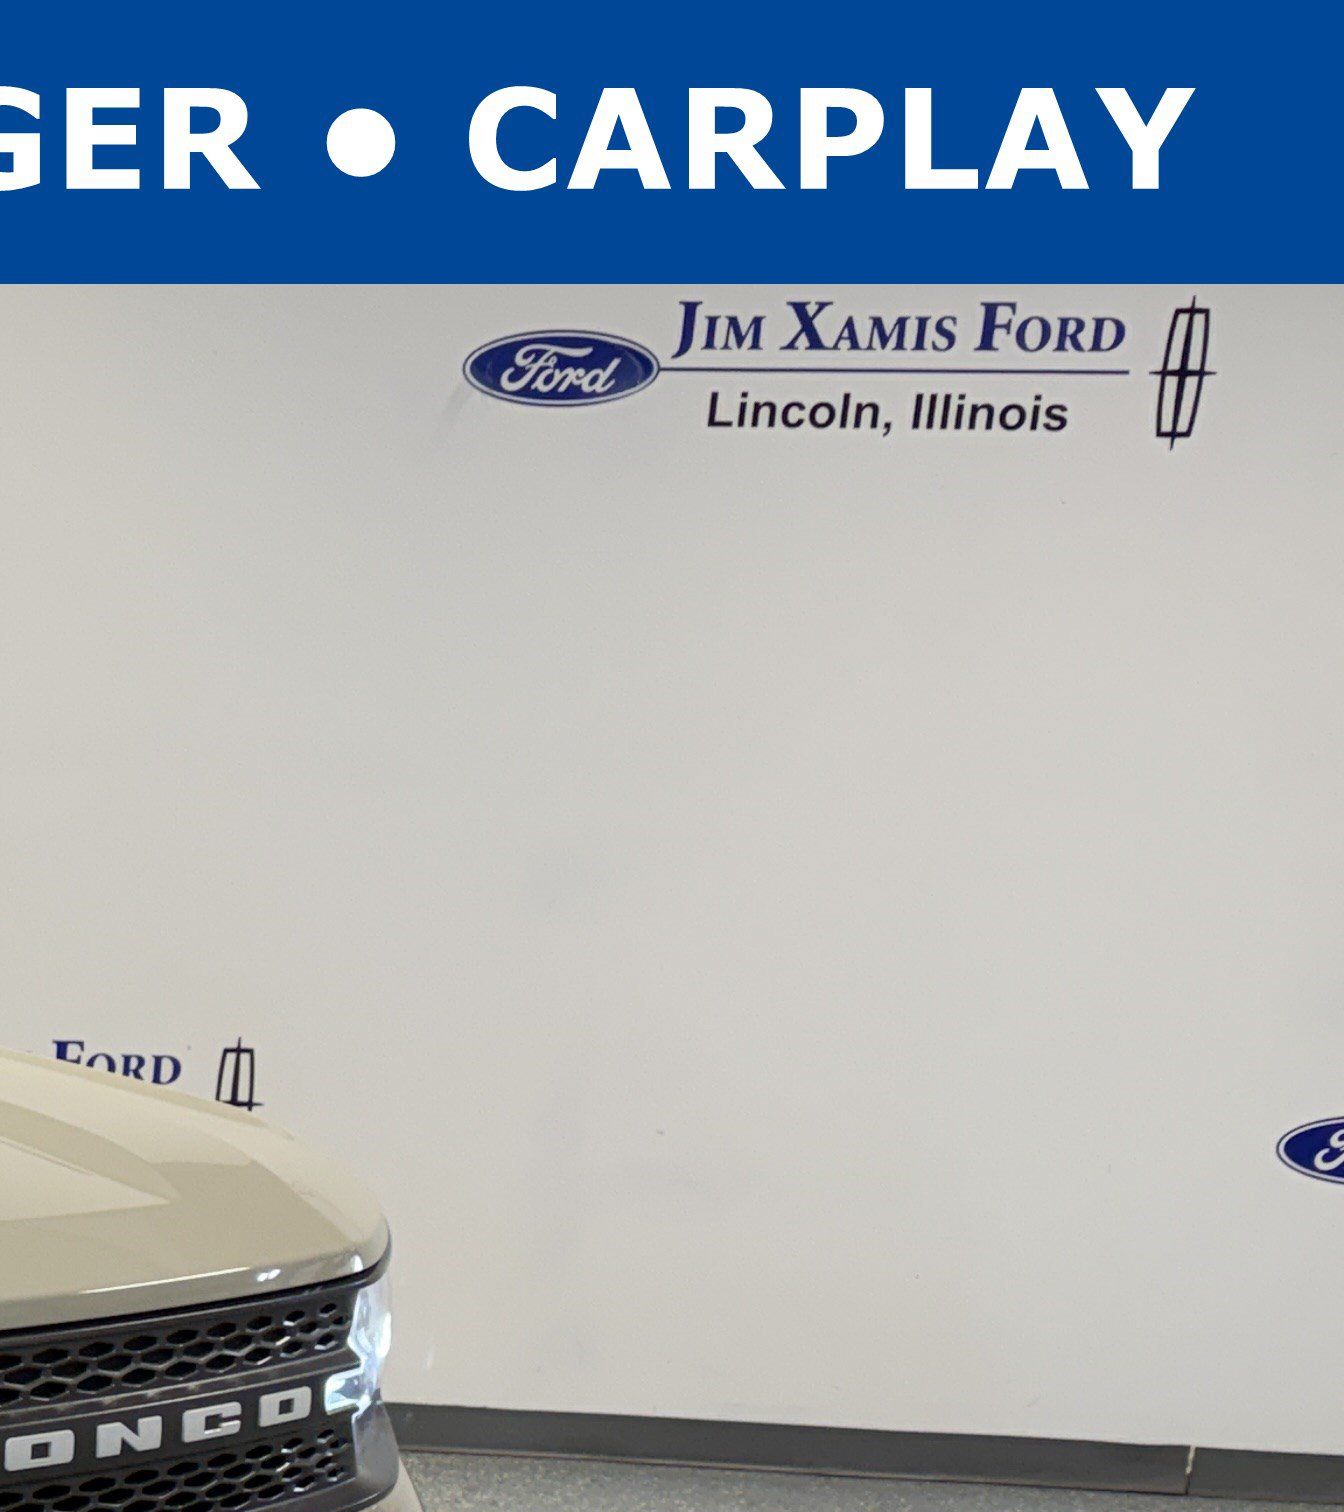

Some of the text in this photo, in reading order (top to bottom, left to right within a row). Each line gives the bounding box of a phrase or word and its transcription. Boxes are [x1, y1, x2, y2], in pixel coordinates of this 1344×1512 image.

[670, 300, 1126, 360] JIM XAMIS FORD
[500, 342, 620, 393] Ford
[707, 391, 1068, 437] Lincoln, Illinois
